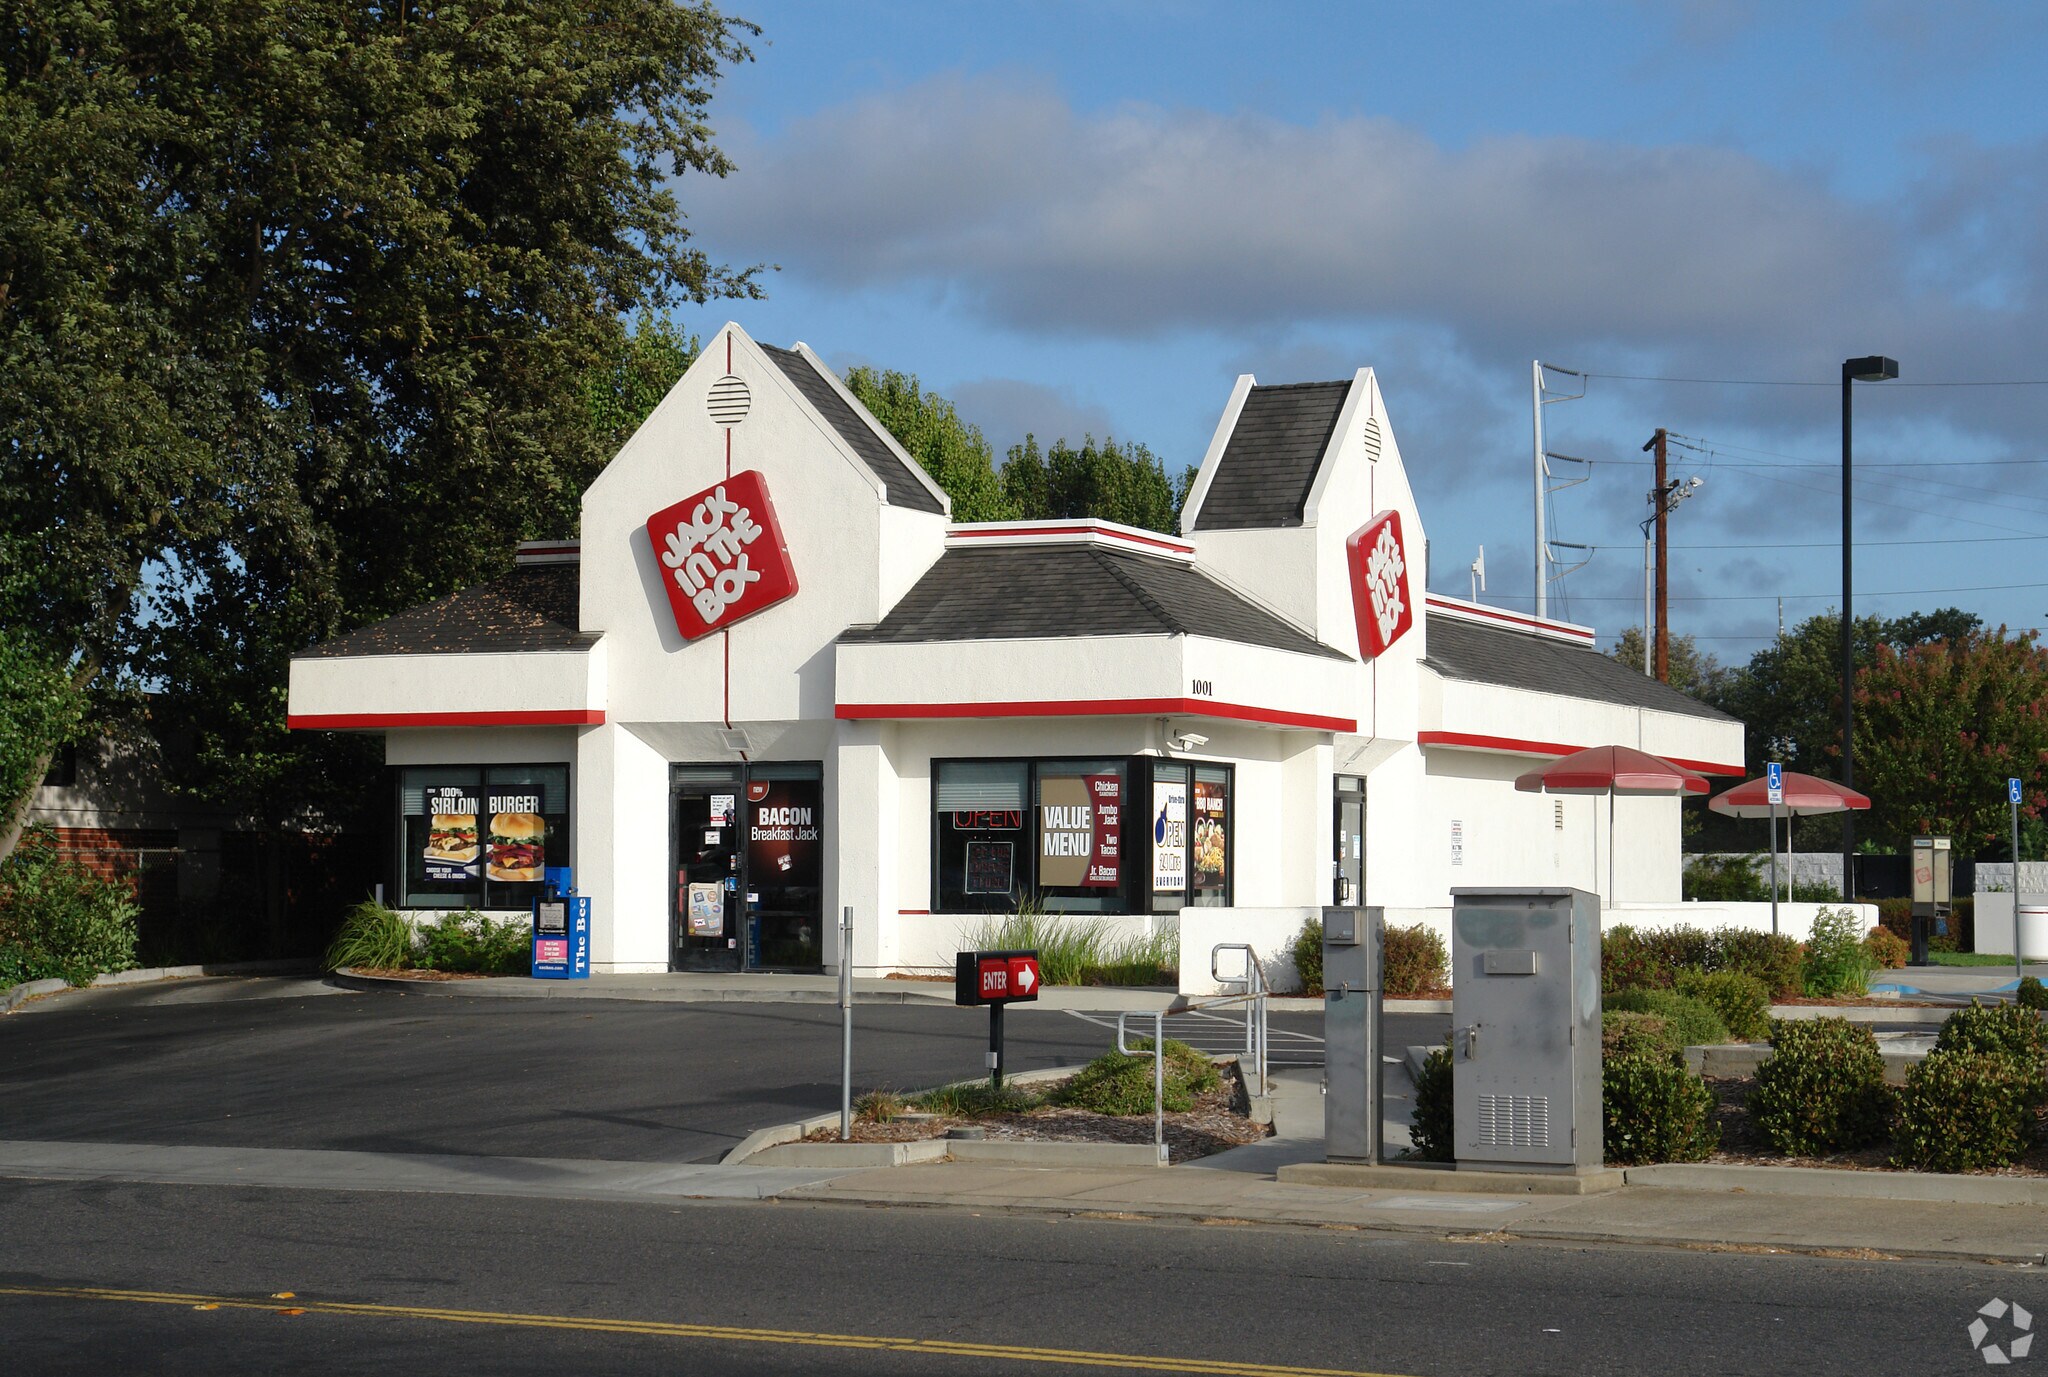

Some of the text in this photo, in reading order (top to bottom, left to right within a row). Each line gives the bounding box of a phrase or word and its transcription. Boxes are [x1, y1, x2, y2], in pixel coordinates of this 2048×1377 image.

[661, 485, 738, 568] JACK
[703, 507, 763, 565] THE
[1366, 520, 1396, 590] JACK
[1382, 543, 1405, 594] THE
[692, 552, 761, 624] BOX
[1377, 585, 1405, 647] BOX
[1192, 679, 1213, 697] 1001
[439, 787, 464, 798] 100%
[1094, 781, 1119, 792] Chicken
[430, 797, 480, 815] SIRLOIN
[488, 795, 540, 814] BURGER
[1097, 804, 1118, 815] Jumbo
[1206, 797, 1224, 812] RANCH
[759, 807, 812, 825] BACON
[955, 809, 1020, 827] OPEN
[1043, 806, 1091, 829] VALUE
[1103, 815, 1118, 825] Jack
[751, 826, 818, 841] Breakfast Jack
[1105, 834, 1117, 845] Two
[1043, 832, 1091, 857] MENU
[1100, 844, 1117, 855] Tacos
[1098, 865, 1117, 876] Bacon
[1159, 853, 1168, 871] 24
[1155, 876, 1184, 886] EVERYDAY
[576, 898, 586, 973] The Bee
[983, 971, 1008, 991] ENTER
